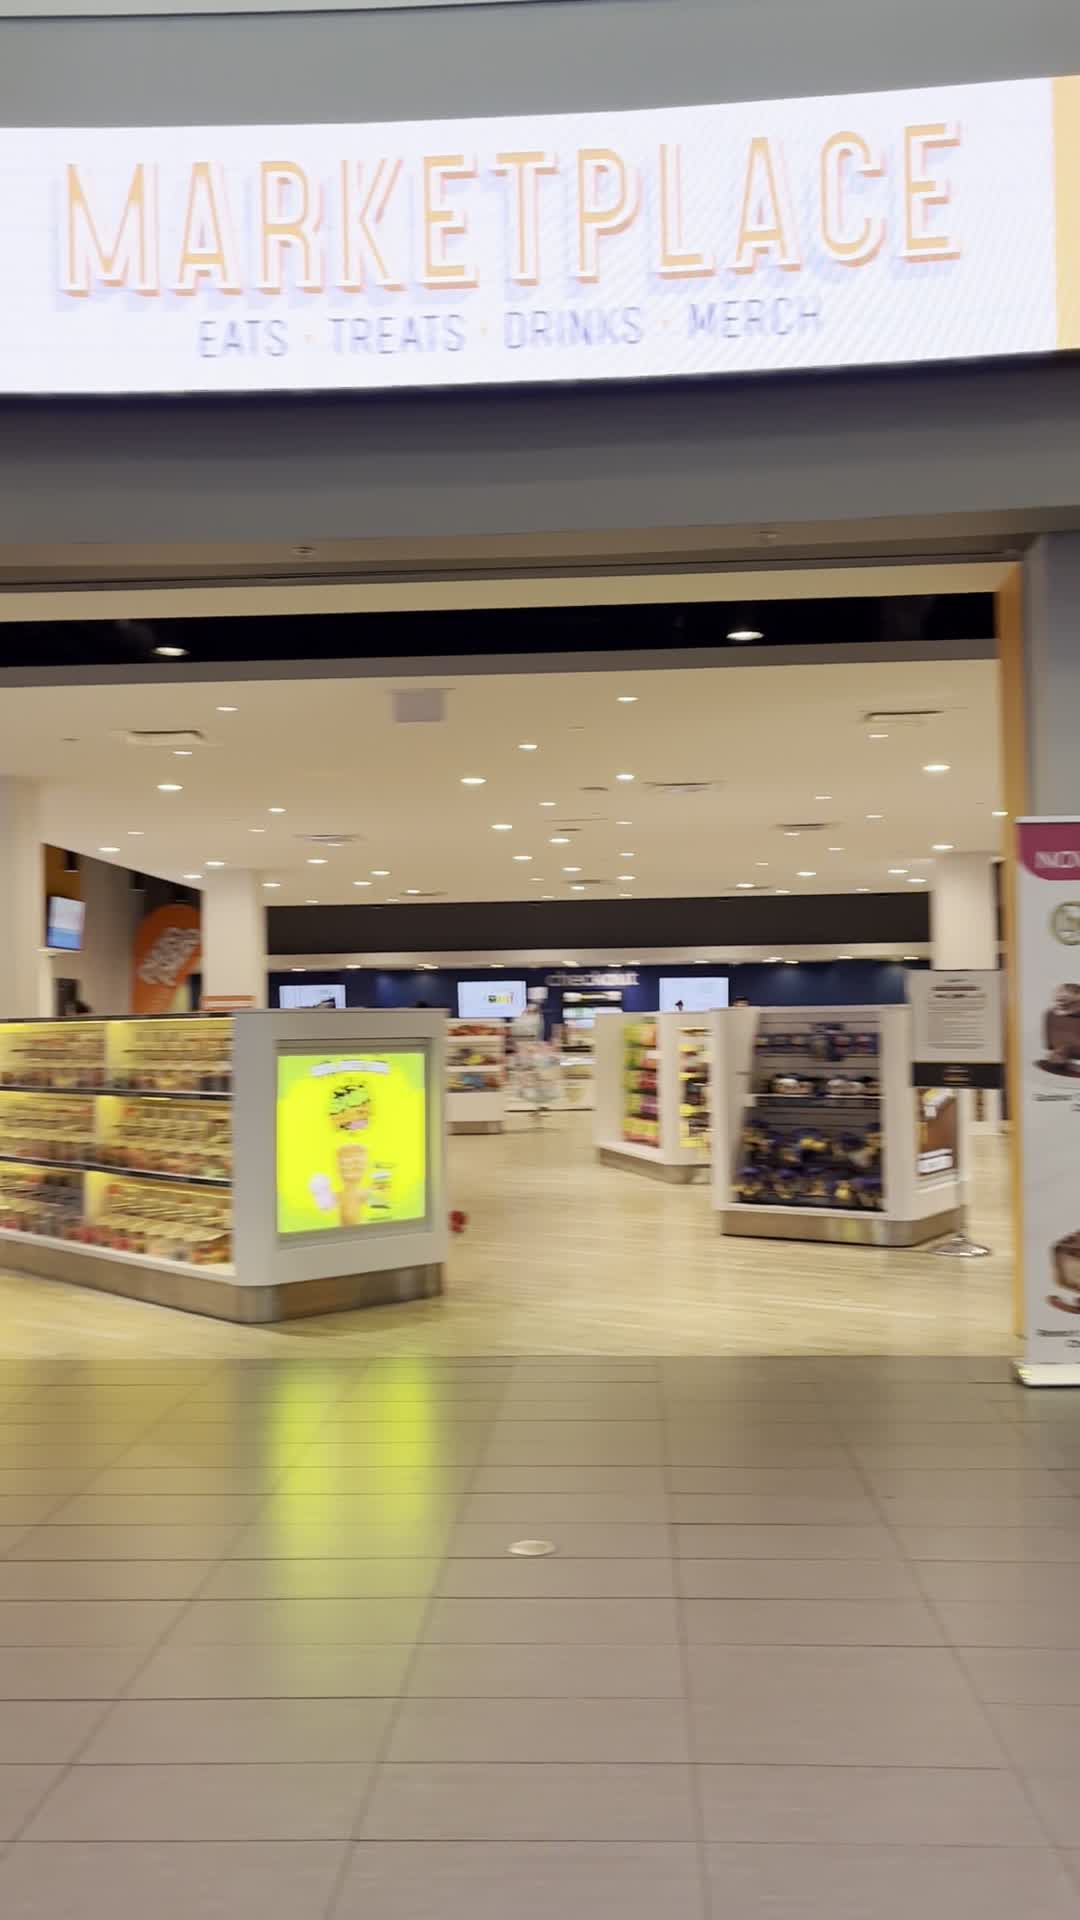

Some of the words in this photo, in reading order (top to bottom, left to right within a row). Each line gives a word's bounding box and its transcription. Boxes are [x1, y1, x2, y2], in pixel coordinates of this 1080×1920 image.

[59, 120, 964, 299] MARKETPLACE
[199, 317, 289, 356] EATS
[329, 312, 467, 353] TREATS
[504, 304, 645, 349] DRINKS
[687, 295, 823, 338] MERCH
